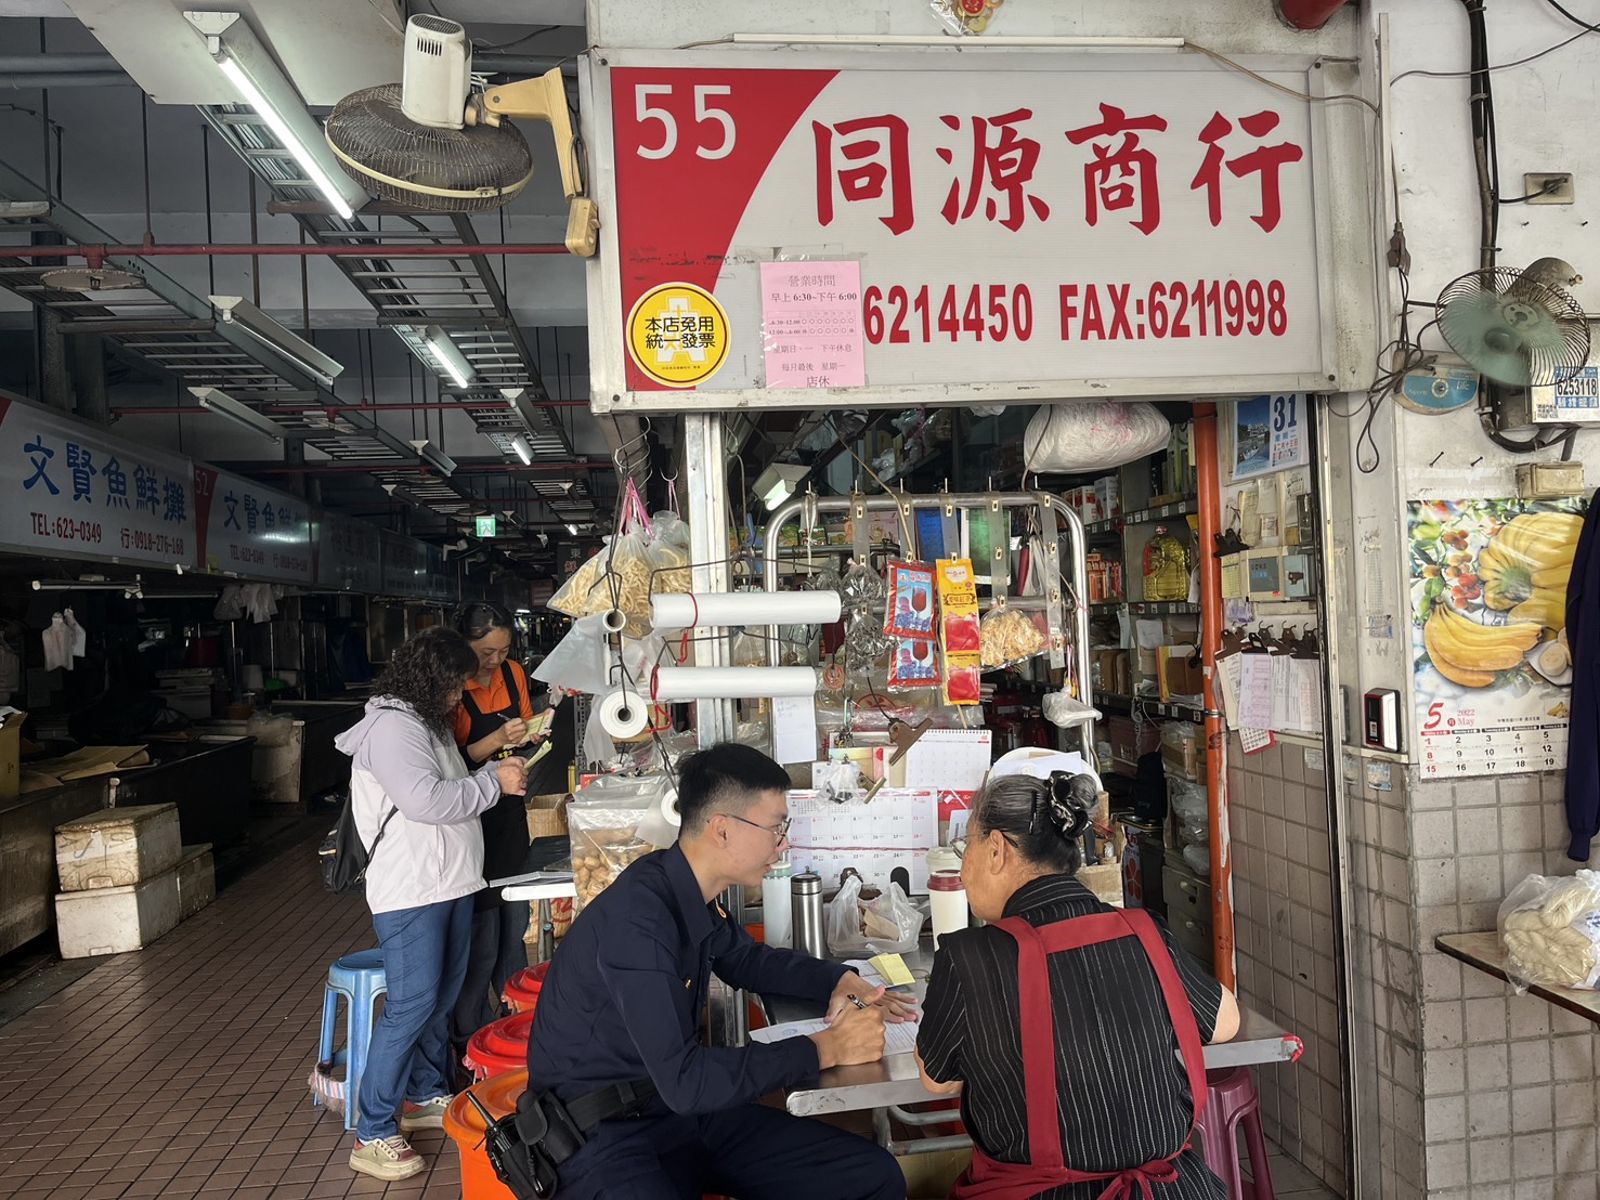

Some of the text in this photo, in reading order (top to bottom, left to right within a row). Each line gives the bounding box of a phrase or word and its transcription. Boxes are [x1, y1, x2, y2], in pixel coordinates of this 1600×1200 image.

[812, 102, 1303, 236] 同源商行
[838, 293, 858, 301] 6:00
[645, 316, 715, 333] 本店免用
[864, 280, 1288, 346] 6214450 FAX:6211998
[645, 332, 716, 350] 統一發票
[806, 375, 830, 388] 店休
[1557, 378, 1597, 395] 6253118
[1273, 393, 1297, 432] 31
[23, 434, 188, 525] 文賢魚鮮攤
[30, 512, 102, 543] TEL:623-0349
[1424, 702, 1444, 730] 5
[1457, 717, 1475, 727] May
